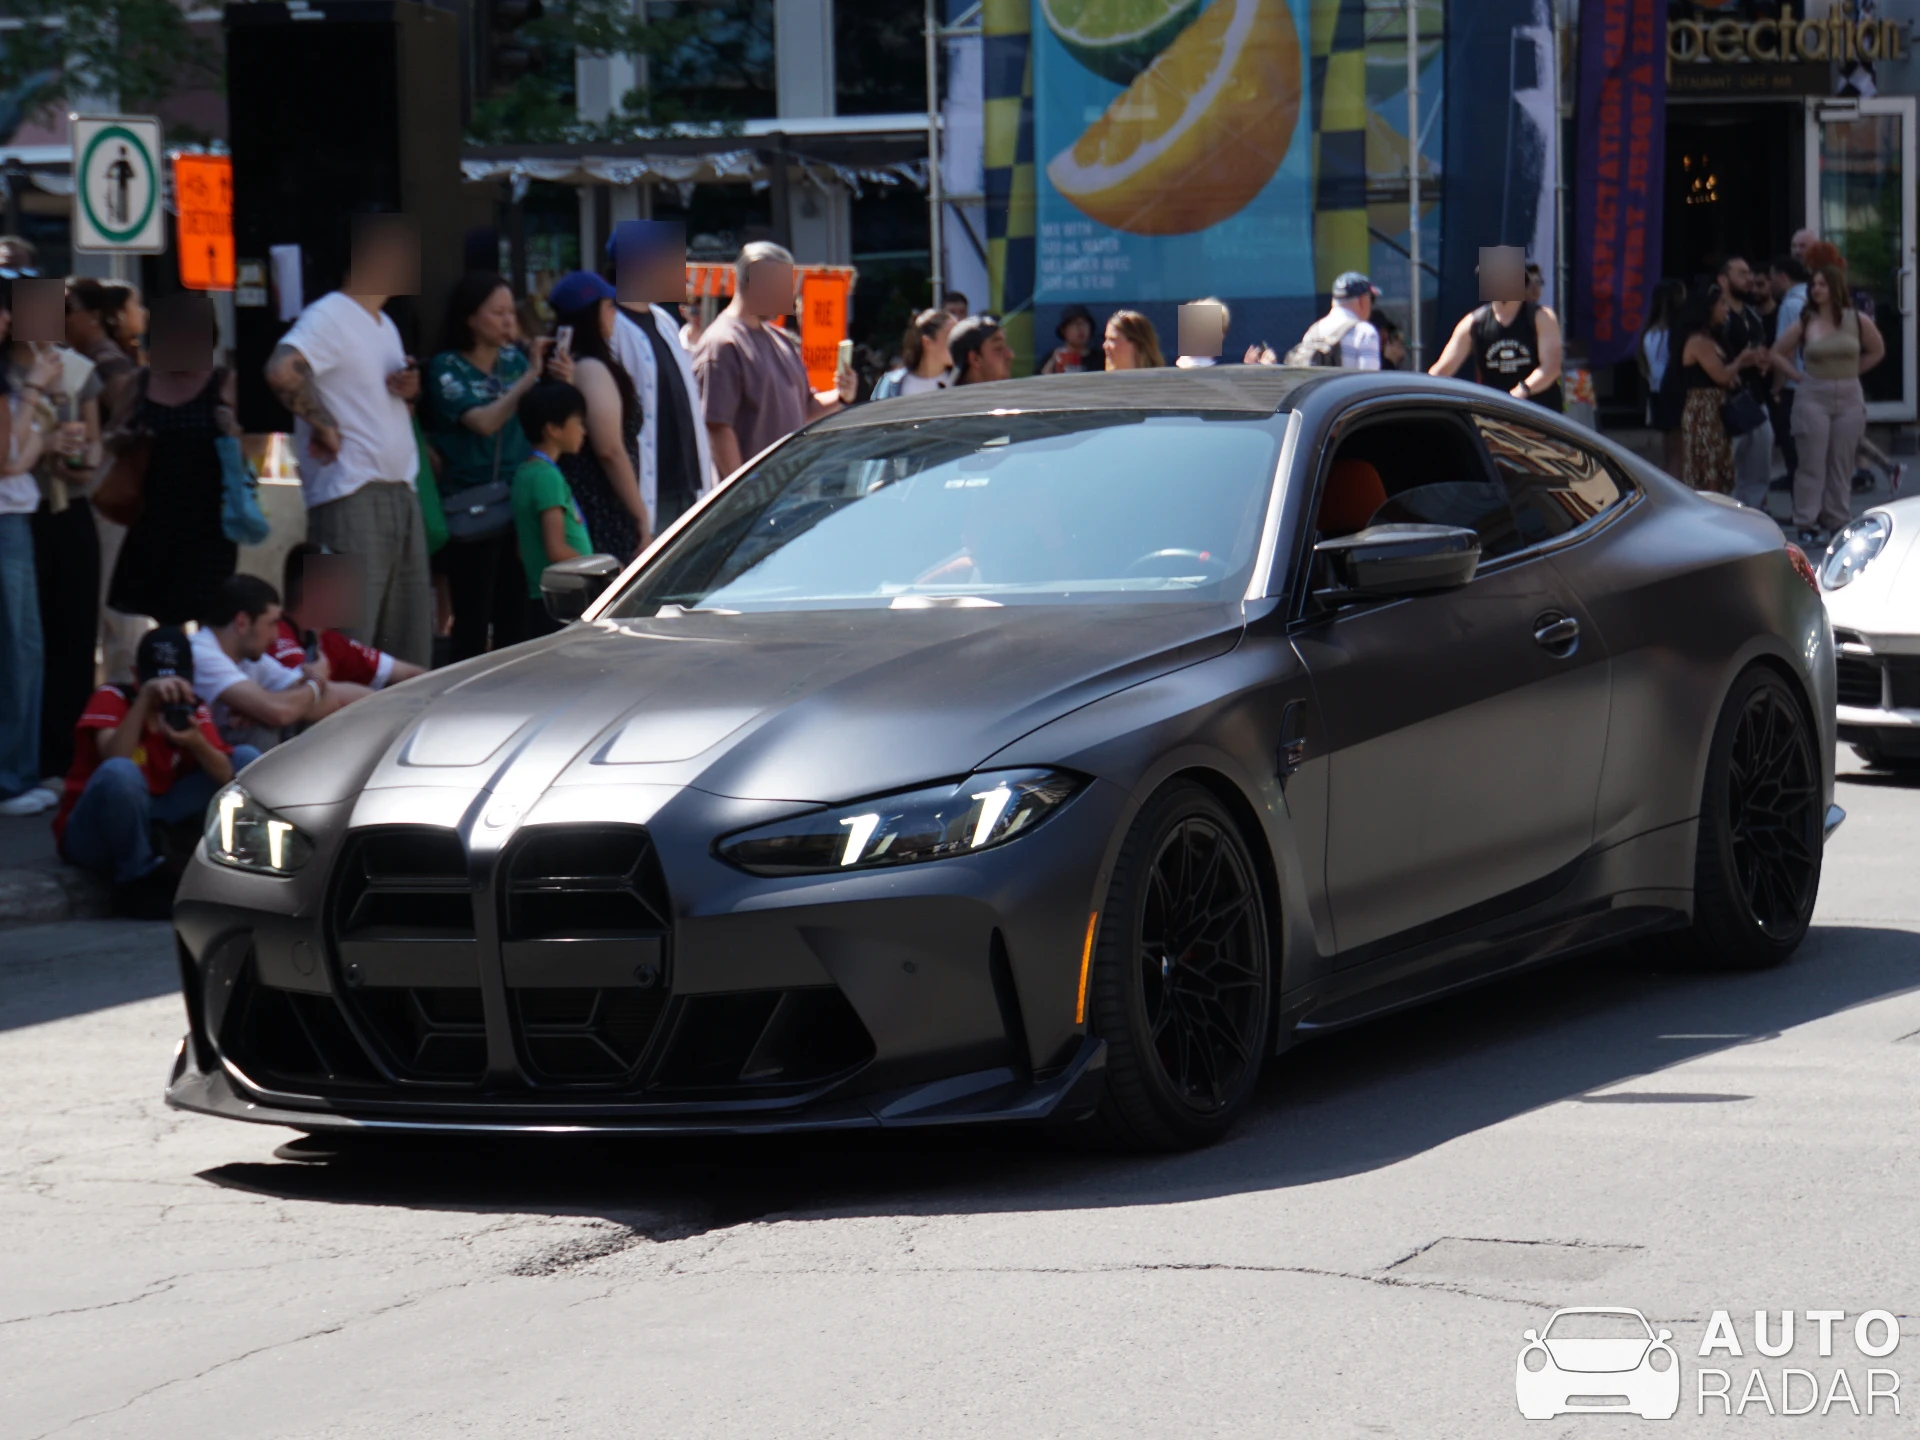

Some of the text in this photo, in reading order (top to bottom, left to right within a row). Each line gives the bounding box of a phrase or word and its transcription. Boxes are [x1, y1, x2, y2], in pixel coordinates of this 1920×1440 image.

[1622, 205, 1645, 331] OUVERT
[813, 300, 833, 327] RUE
[803, 342, 838, 372] BARRÉ
